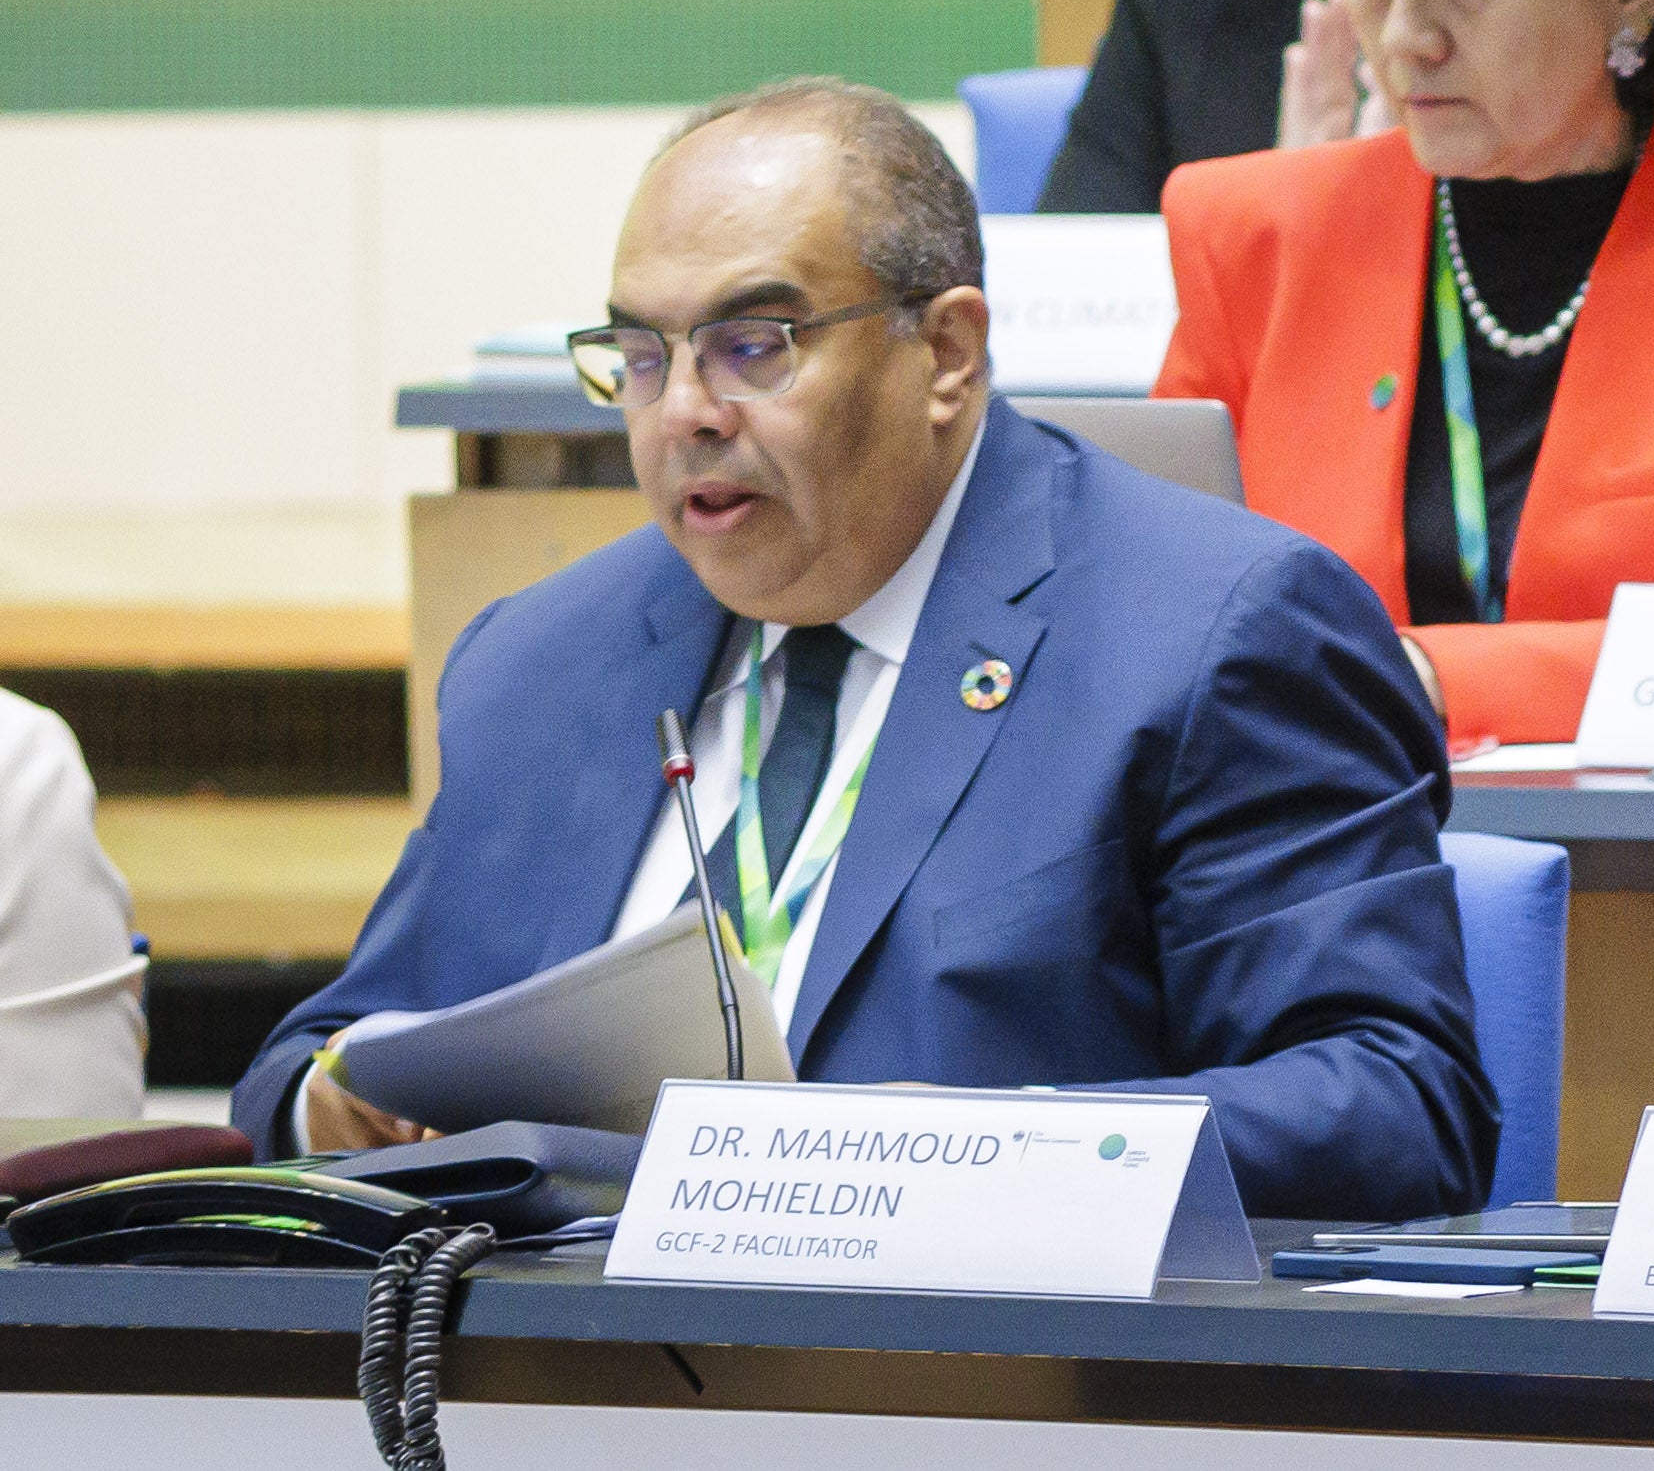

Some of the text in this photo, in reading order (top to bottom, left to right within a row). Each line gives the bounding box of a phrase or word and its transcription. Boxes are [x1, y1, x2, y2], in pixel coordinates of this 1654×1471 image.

[688, 1125, 1001, 1166] DR. MAHMOUD
[669, 1178, 904, 1218] MOHIELDIN
[655, 1231, 878, 1260] GCF-2 FACILITATOR
